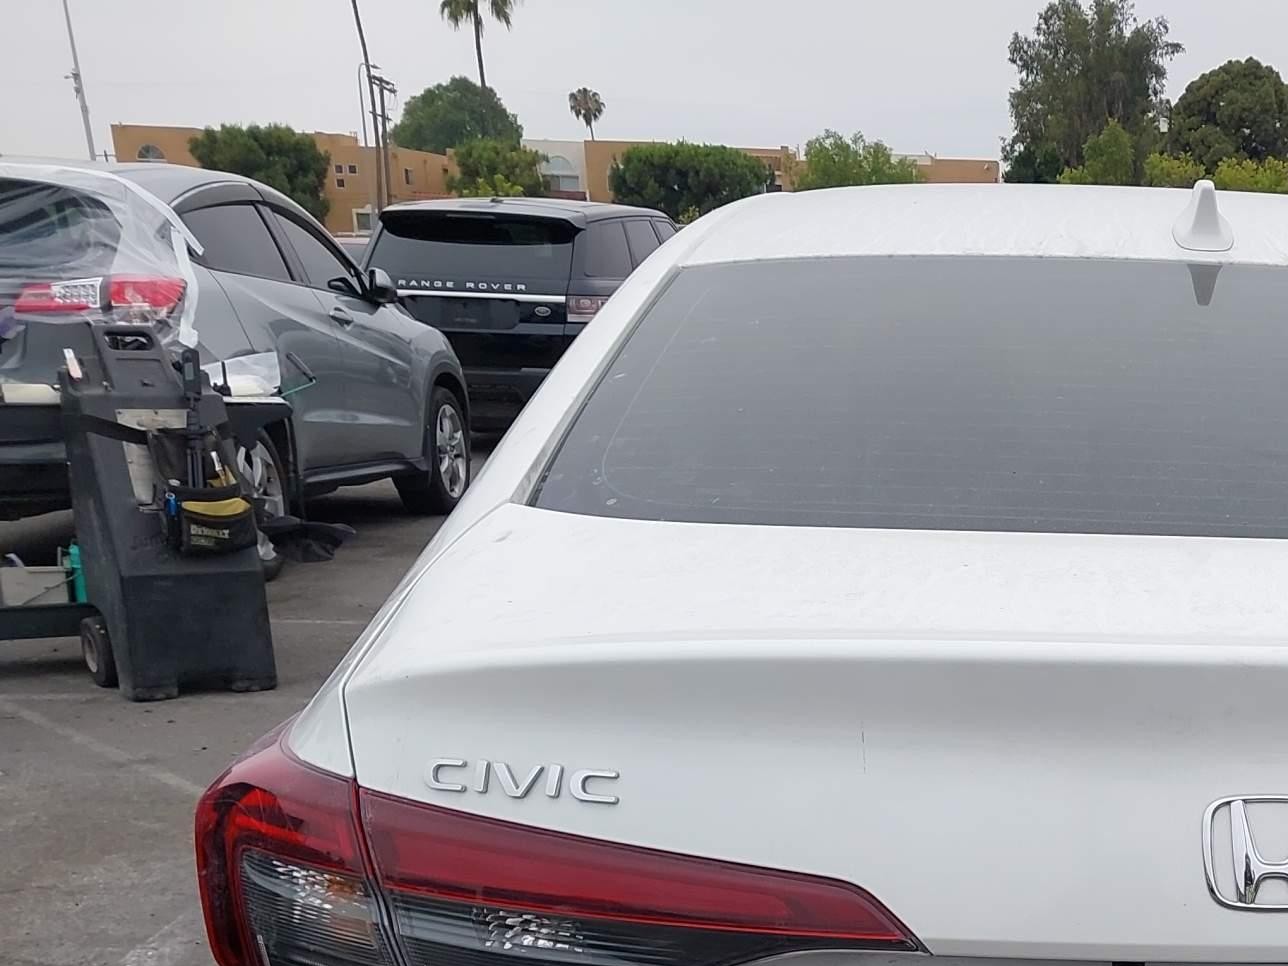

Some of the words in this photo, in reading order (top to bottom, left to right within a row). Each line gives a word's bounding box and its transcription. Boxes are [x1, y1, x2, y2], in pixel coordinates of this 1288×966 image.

[398, 279, 455, 288] RANGE
[465, 282, 527, 291] ROVER
[425, 757, 619, 804] CIVIC
